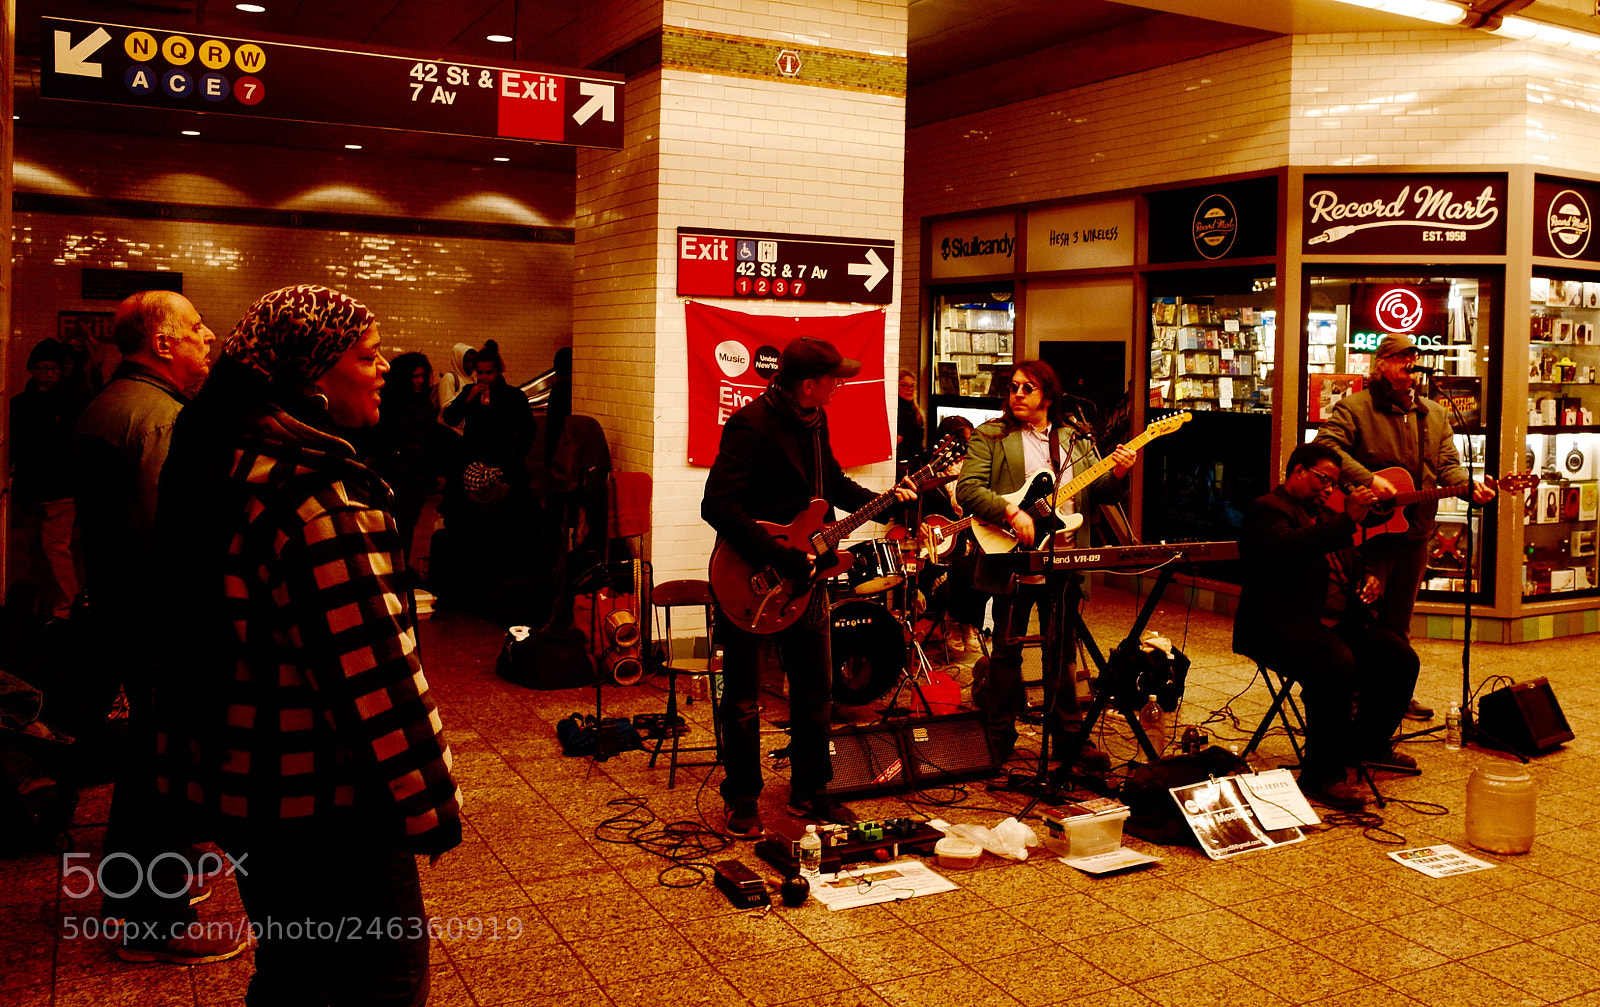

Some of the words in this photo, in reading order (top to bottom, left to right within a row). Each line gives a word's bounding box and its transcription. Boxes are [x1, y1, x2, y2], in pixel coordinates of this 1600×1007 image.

[133, 37, 149, 55] N
[170, 42, 187, 60] Q
[208, 45, 223, 63] R
[240, 50, 261, 68] W
[131, 70, 149, 89] A
[169, 74, 186, 93] C
[206, 78, 221, 96] E
[243, 83, 257, 100] 7
[410, 62, 438, 83] 42
[446, 66, 470, 86] St
[477, 70, 493, 89] &
[501, 71, 558, 102] Exit
[410, 82, 424, 102] 7
[430, 85, 457, 105] Av
[1309, 185, 1410, 224] Record
[1413, 185, 1498, 221] Mart
[951, 232, 1015, 259] Skullcandy
[1049, 229, 1070, 247] HESH
[1072, 230, 1079, 244] 3
[1082, 226, 1119, 243] WIRELESS
[1422, 231, 1444, 242] EST.
[1445, 231, 1467, 242] 1958
[681, 237, 729, 261] Exit
[736, 261, 756, 277] 42
[760, 263, 777, 277] St
[781, 264, 793, 278] &
[797, 264, 807, 278] 7
[811, 265, 828, 280] Av
[758, 280, 767, 292] 2
[776, 281, 785, 293] 3
[794, 282, 802, 294] 7
[718, 352, 746, 364] Music
[1043, 555, 1070, 565] Rland
[1073, 554, 1101, 563] VR-09
